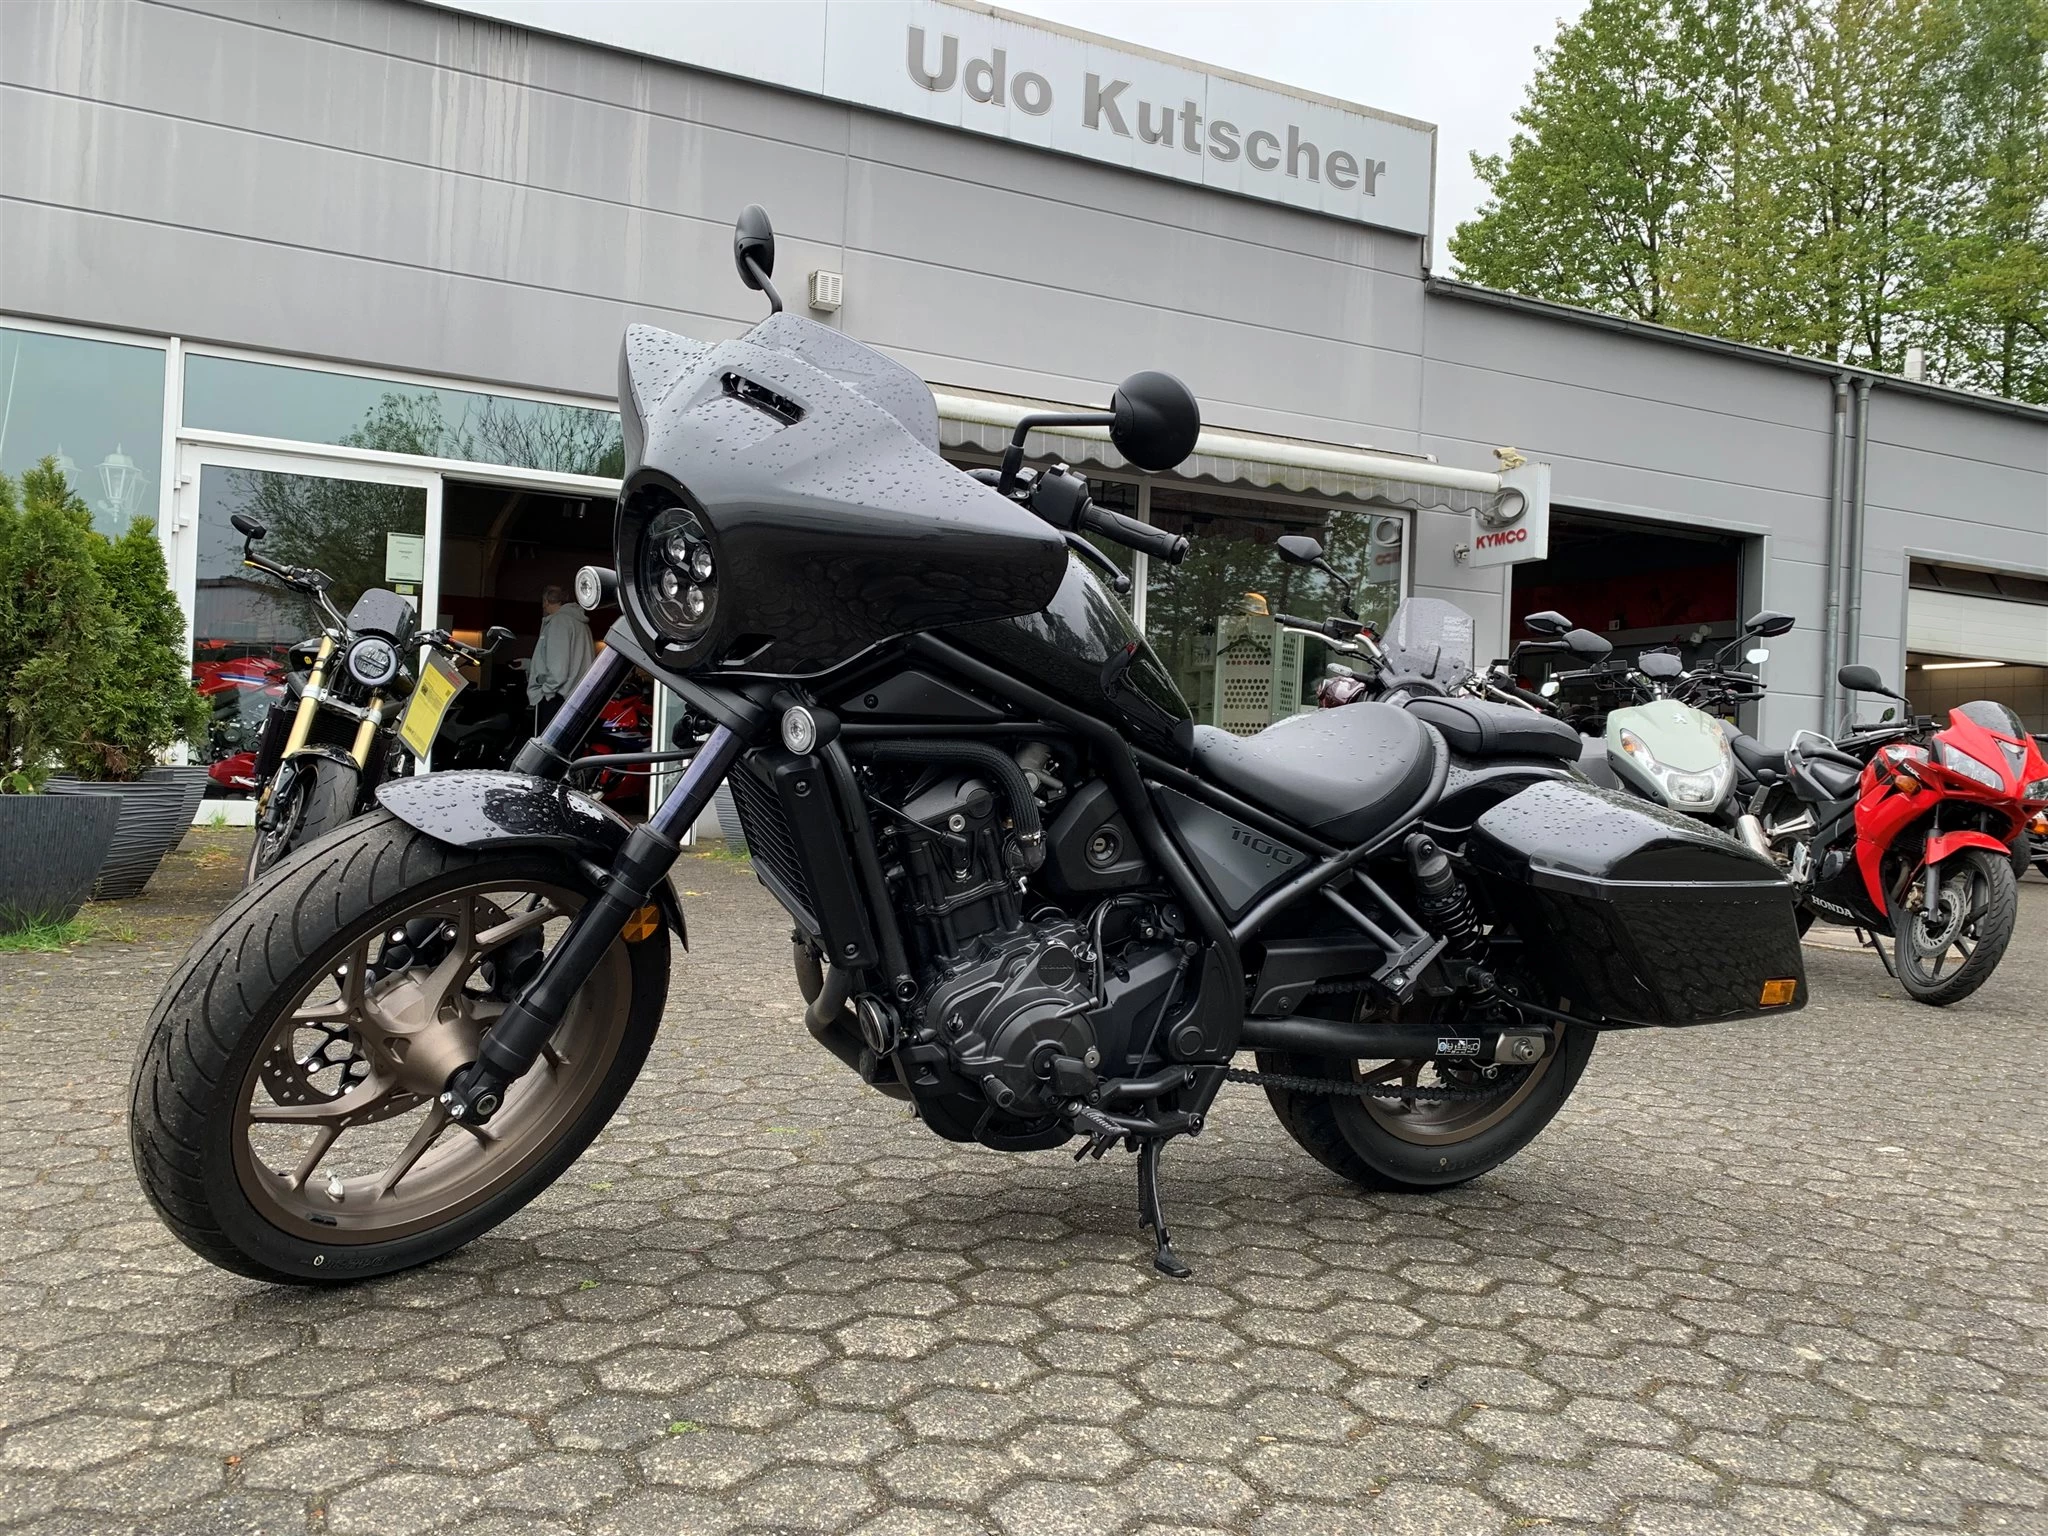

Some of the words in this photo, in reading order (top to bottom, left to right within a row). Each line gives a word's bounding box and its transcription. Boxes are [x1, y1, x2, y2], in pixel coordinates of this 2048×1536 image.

[906, 24, 1054, 116] Udo
[1081, 71, 1387, 197] Kutscher
[1476, 528, 1527, 549] KYMCO
[1231, 826, 1293, 865] 1100
[1811, 895, 1855, 919] HONDA
